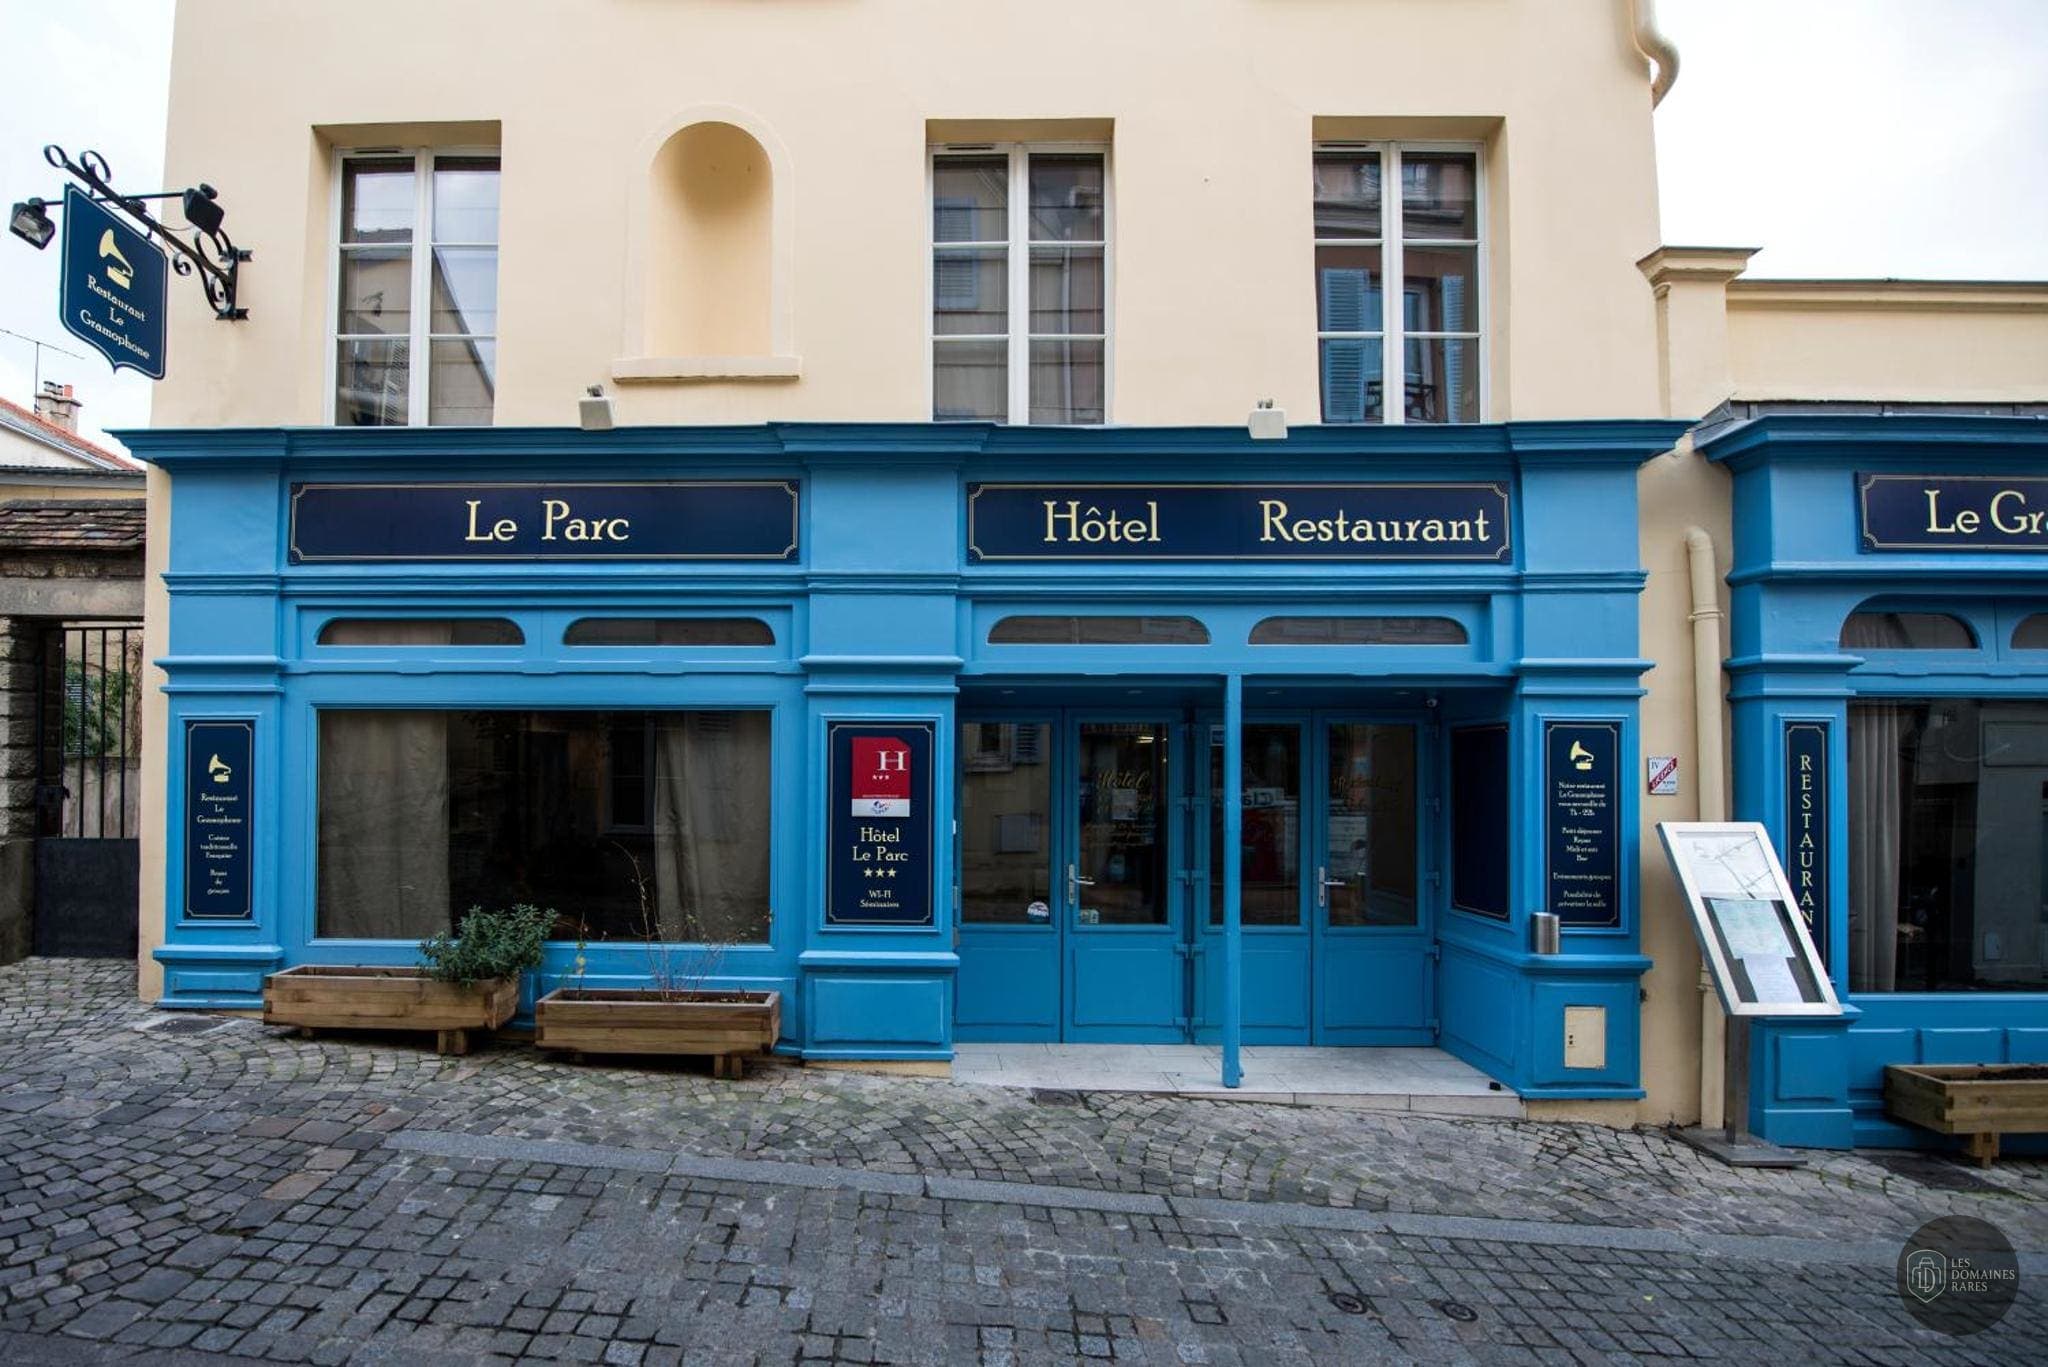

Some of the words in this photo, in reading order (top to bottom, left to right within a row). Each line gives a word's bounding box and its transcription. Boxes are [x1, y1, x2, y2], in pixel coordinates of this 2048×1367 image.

[87, 273, 146, 322] Restaurant
[109, 307, 124, 326] Le
[80, 309, 150, 360] Gramophone
[465, 500, 518, 542] Le
[541, 500, 630, 542] Parc
[1043, 500, 1162, 543] Hôtel
[1259, 500, 1490, 543] Restaurant
[1924, 489, 1980, 534] Le
[1990, 489, 2048, 534] Gr
[877, 750, 908, 771] H
[852, 846, 871, 861] Le
[876, 846, 909, 861] Parc
[860, 827, 900, 843] Hôtel
[1799, 754, 1816, 928] RESTAURAN
